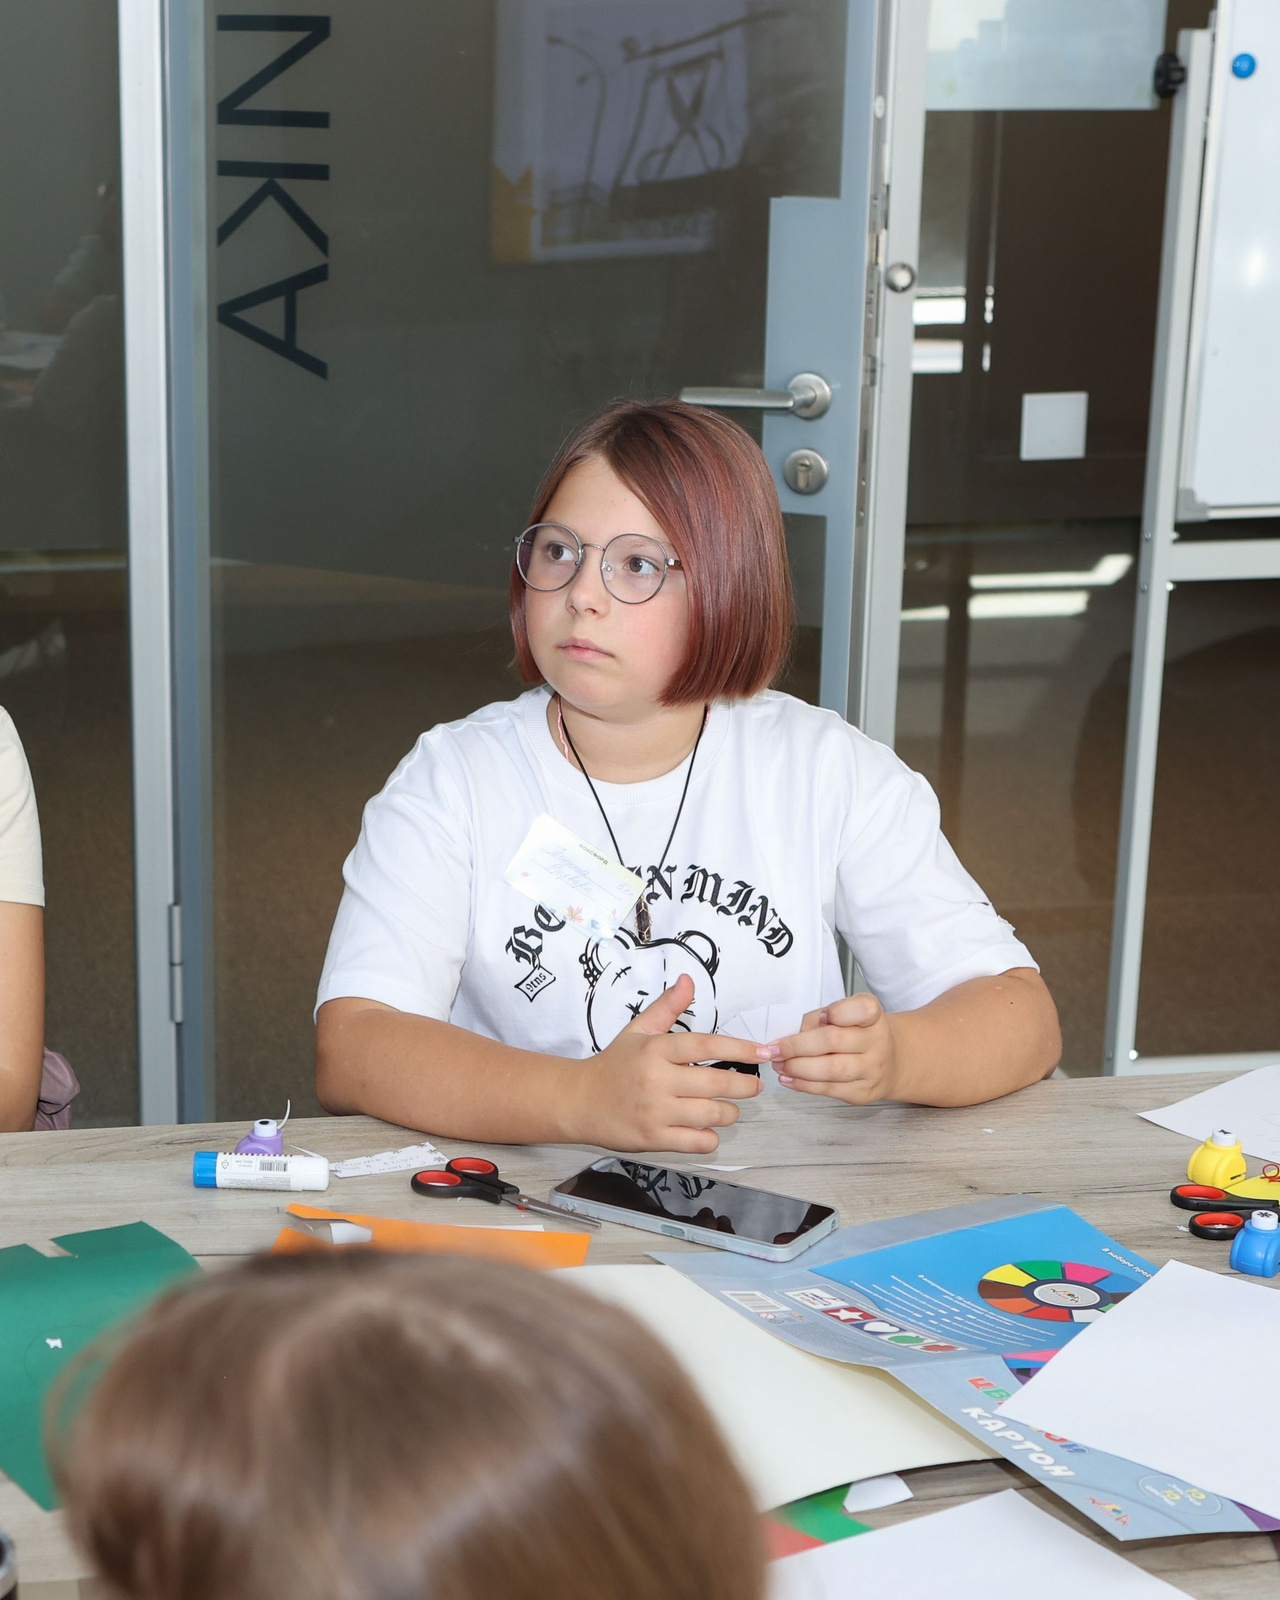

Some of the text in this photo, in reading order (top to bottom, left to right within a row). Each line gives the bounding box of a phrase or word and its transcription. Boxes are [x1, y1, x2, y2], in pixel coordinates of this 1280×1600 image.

[578, 843, 609, 866] ФОКСФОРД
[681, 864, 794, 958] MIND
[961, 1407, 1076, 1477] КАРТОН
